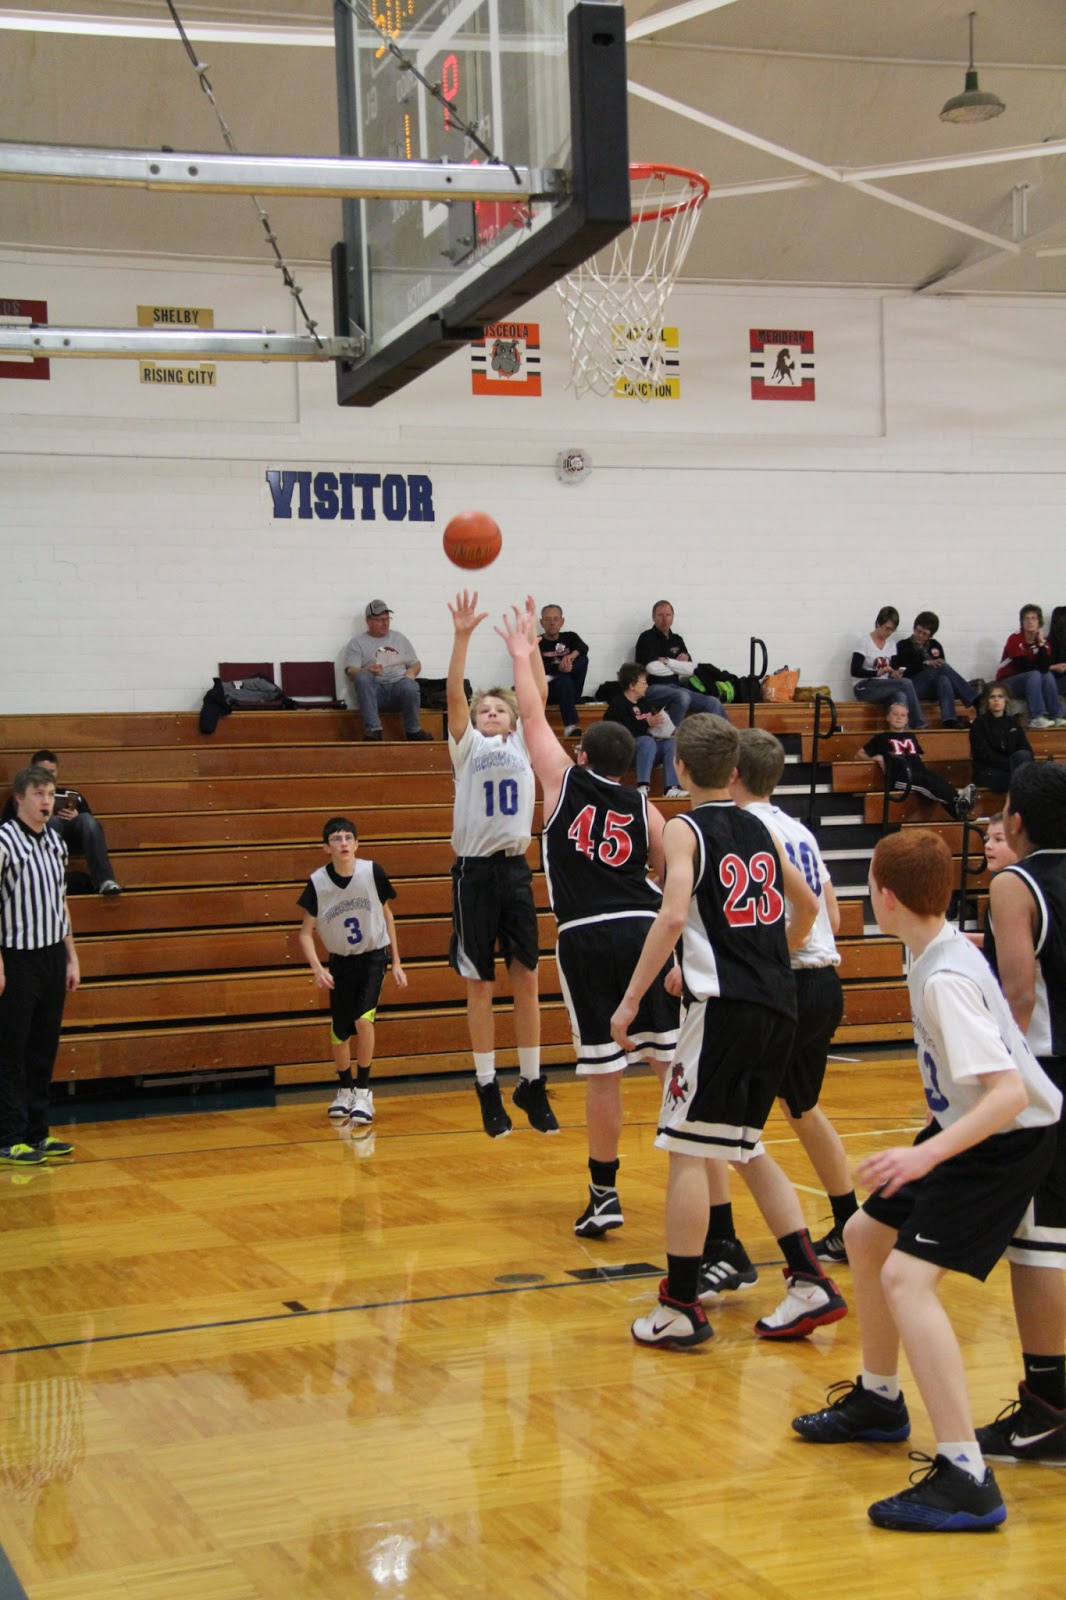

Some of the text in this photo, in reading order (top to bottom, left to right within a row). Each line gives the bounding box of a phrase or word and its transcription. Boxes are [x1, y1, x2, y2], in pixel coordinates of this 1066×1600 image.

[153, 308, 199, 324] SHELBY
[758, 330, 805, 344] MERIDIAN
[143, 367, 214, 386] RISING CITY
[266, 470, 435, 522] VISITOR
[890, 738, 917, 755] M
[483, 779, 518, 816] 10
[568, 804, 635, 868] 45
[719, 852, 784, 927] 23
[344, 917, 362, 945] 3
